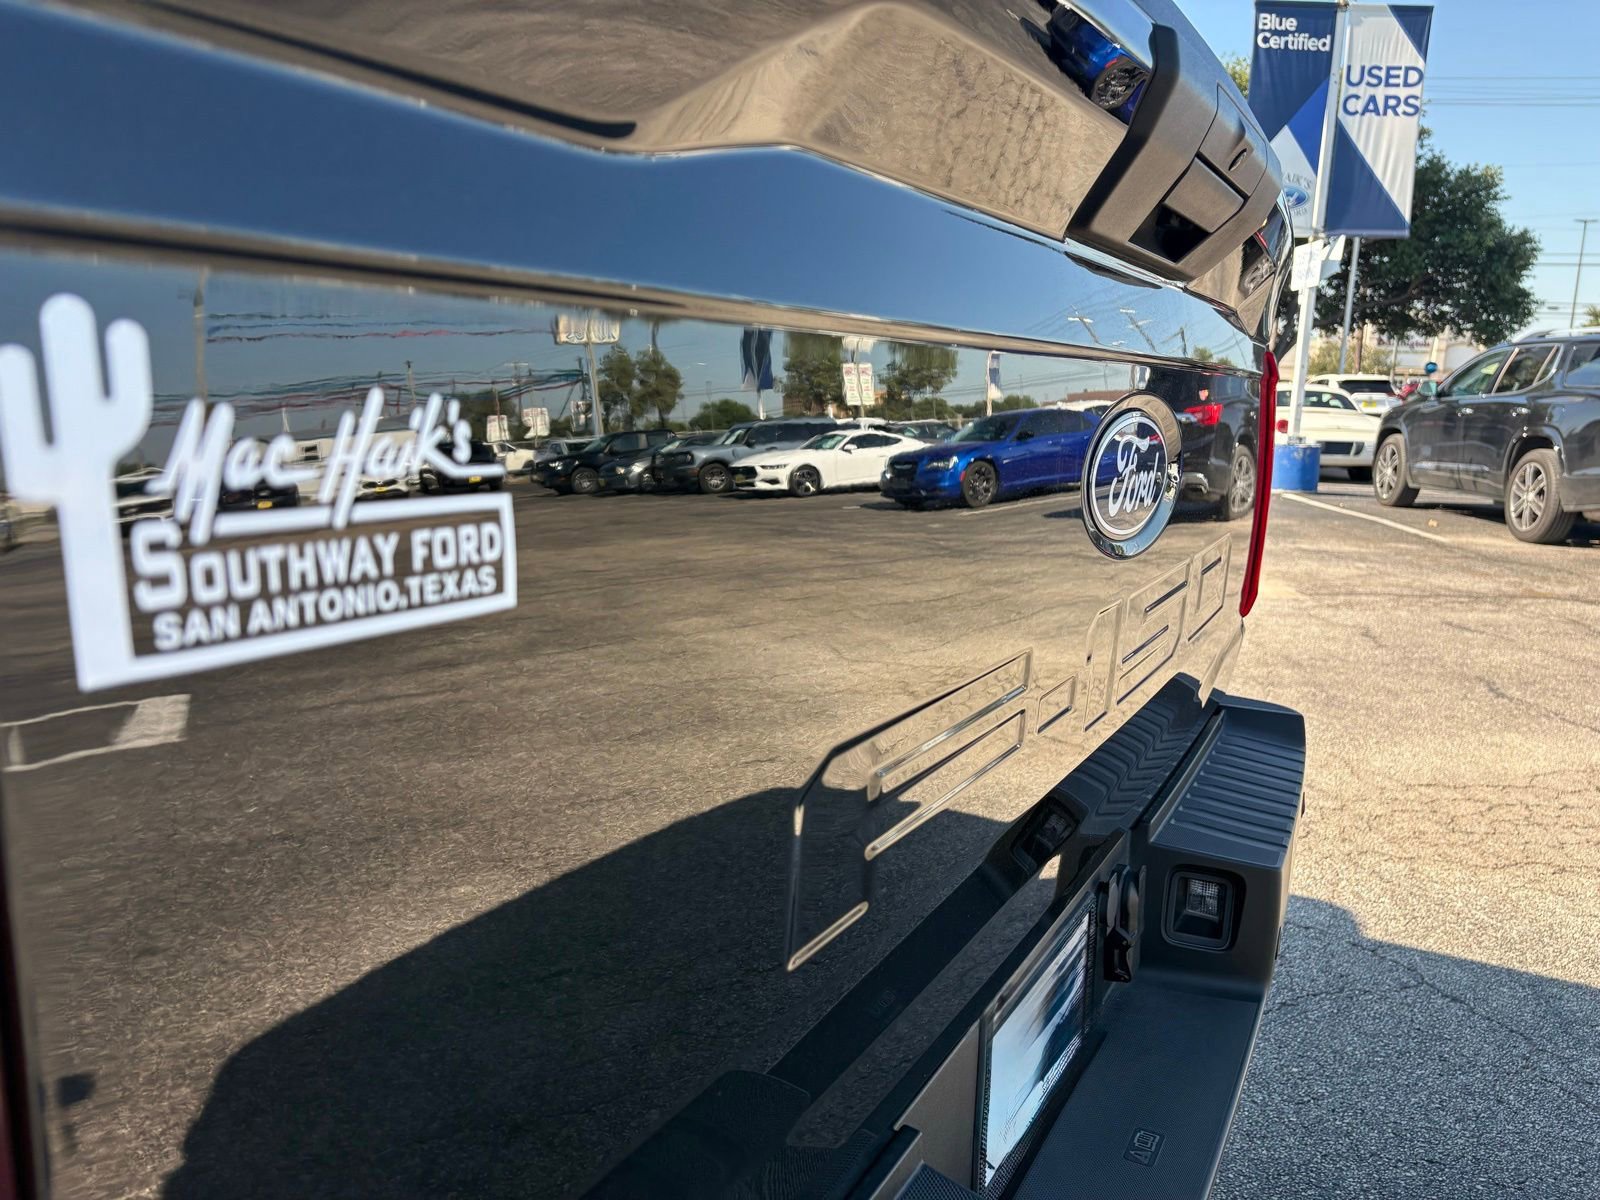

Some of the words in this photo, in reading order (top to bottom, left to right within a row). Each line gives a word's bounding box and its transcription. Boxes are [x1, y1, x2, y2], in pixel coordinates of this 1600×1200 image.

[1257, 13, 1298, 31] Blue
[1256, 32, 1331, 52] Certified
[1345, 64, 1424, 89] USED
[1341, 94, 1421, 118] CARS
[146, 398, 319, 546] Mac
[318, 386, 506, 530] Haik's
[1108, 434, 1159, 518] Ford
[130, 518, 400, 614] SOUTHWAY
[410, 521, 503, 574] FORD
[153, 602, 242, 651] SAN
